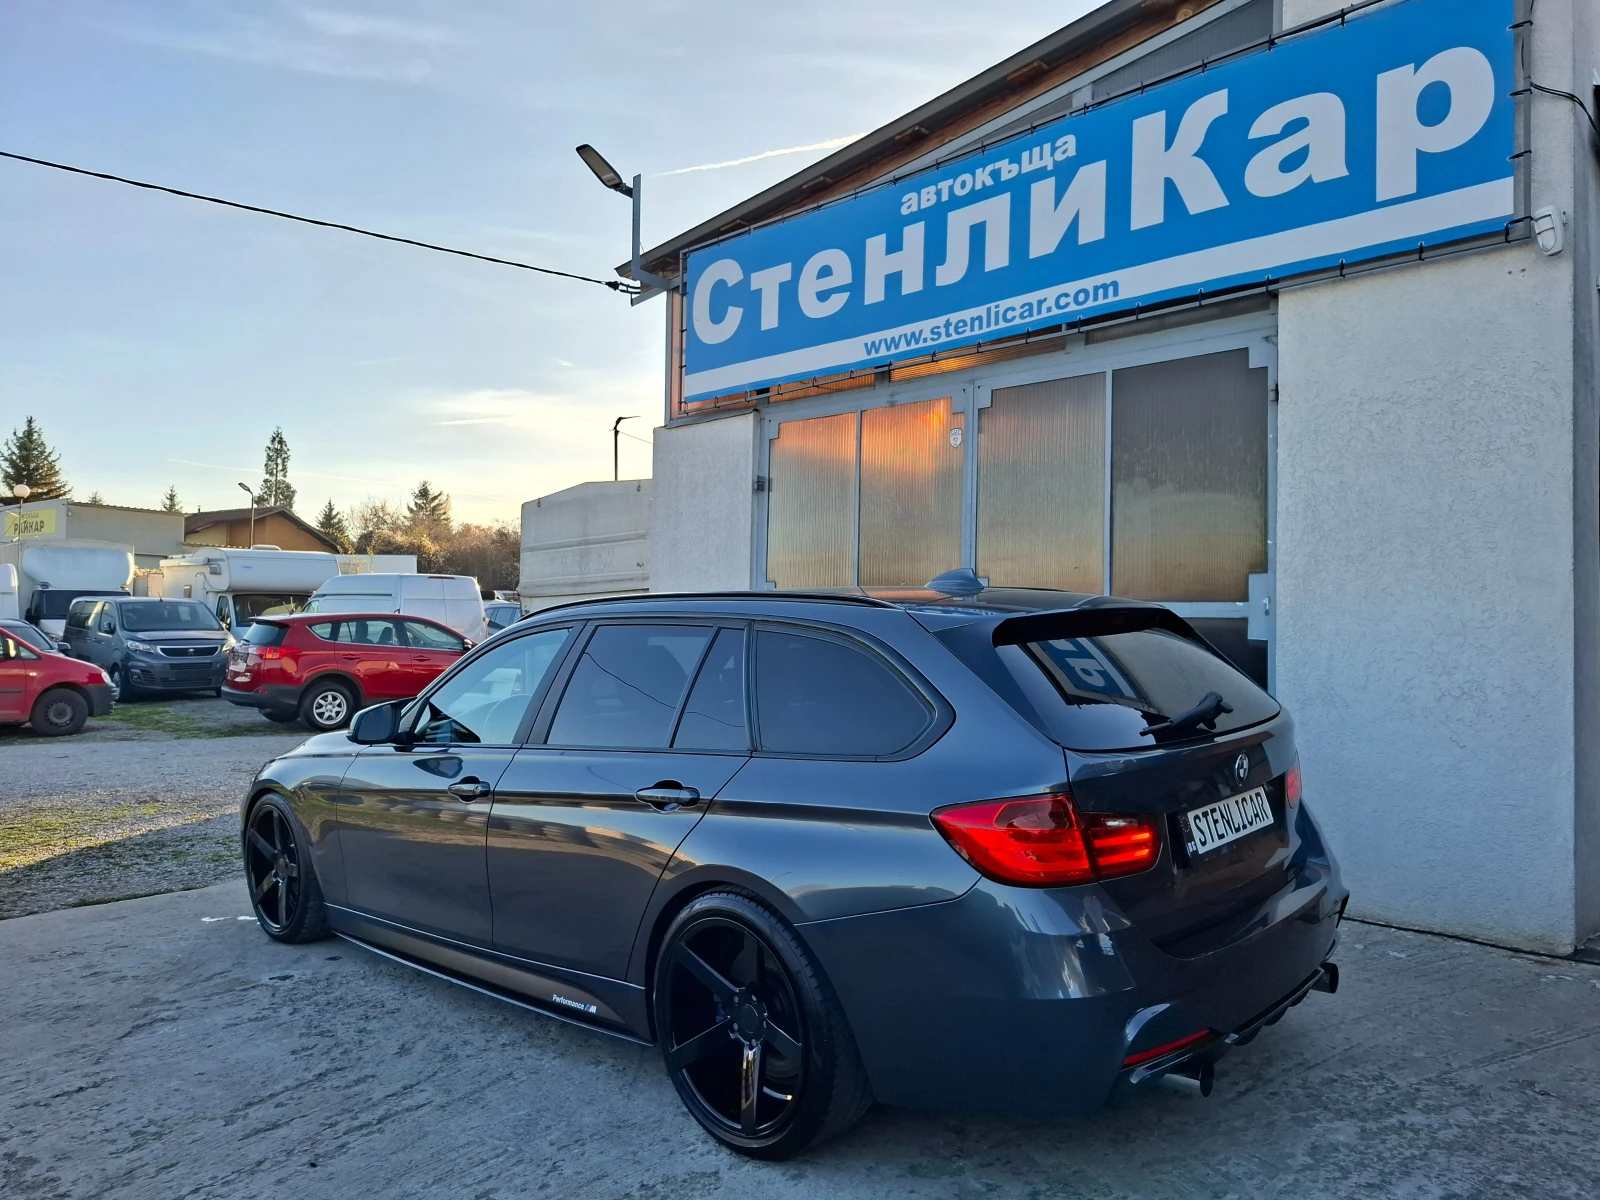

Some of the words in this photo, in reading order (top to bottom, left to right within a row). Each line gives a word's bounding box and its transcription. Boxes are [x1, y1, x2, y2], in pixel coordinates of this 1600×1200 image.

[692, 46, 1496, 345] СтенлиКар
[900, 134, 1077, 216] автокъща
[864, 279, 1120, 357] www.stenlicar.com
[1193, 791, 1270, 847] STENLICAR
[552, 994, 584, 1010] Performance
